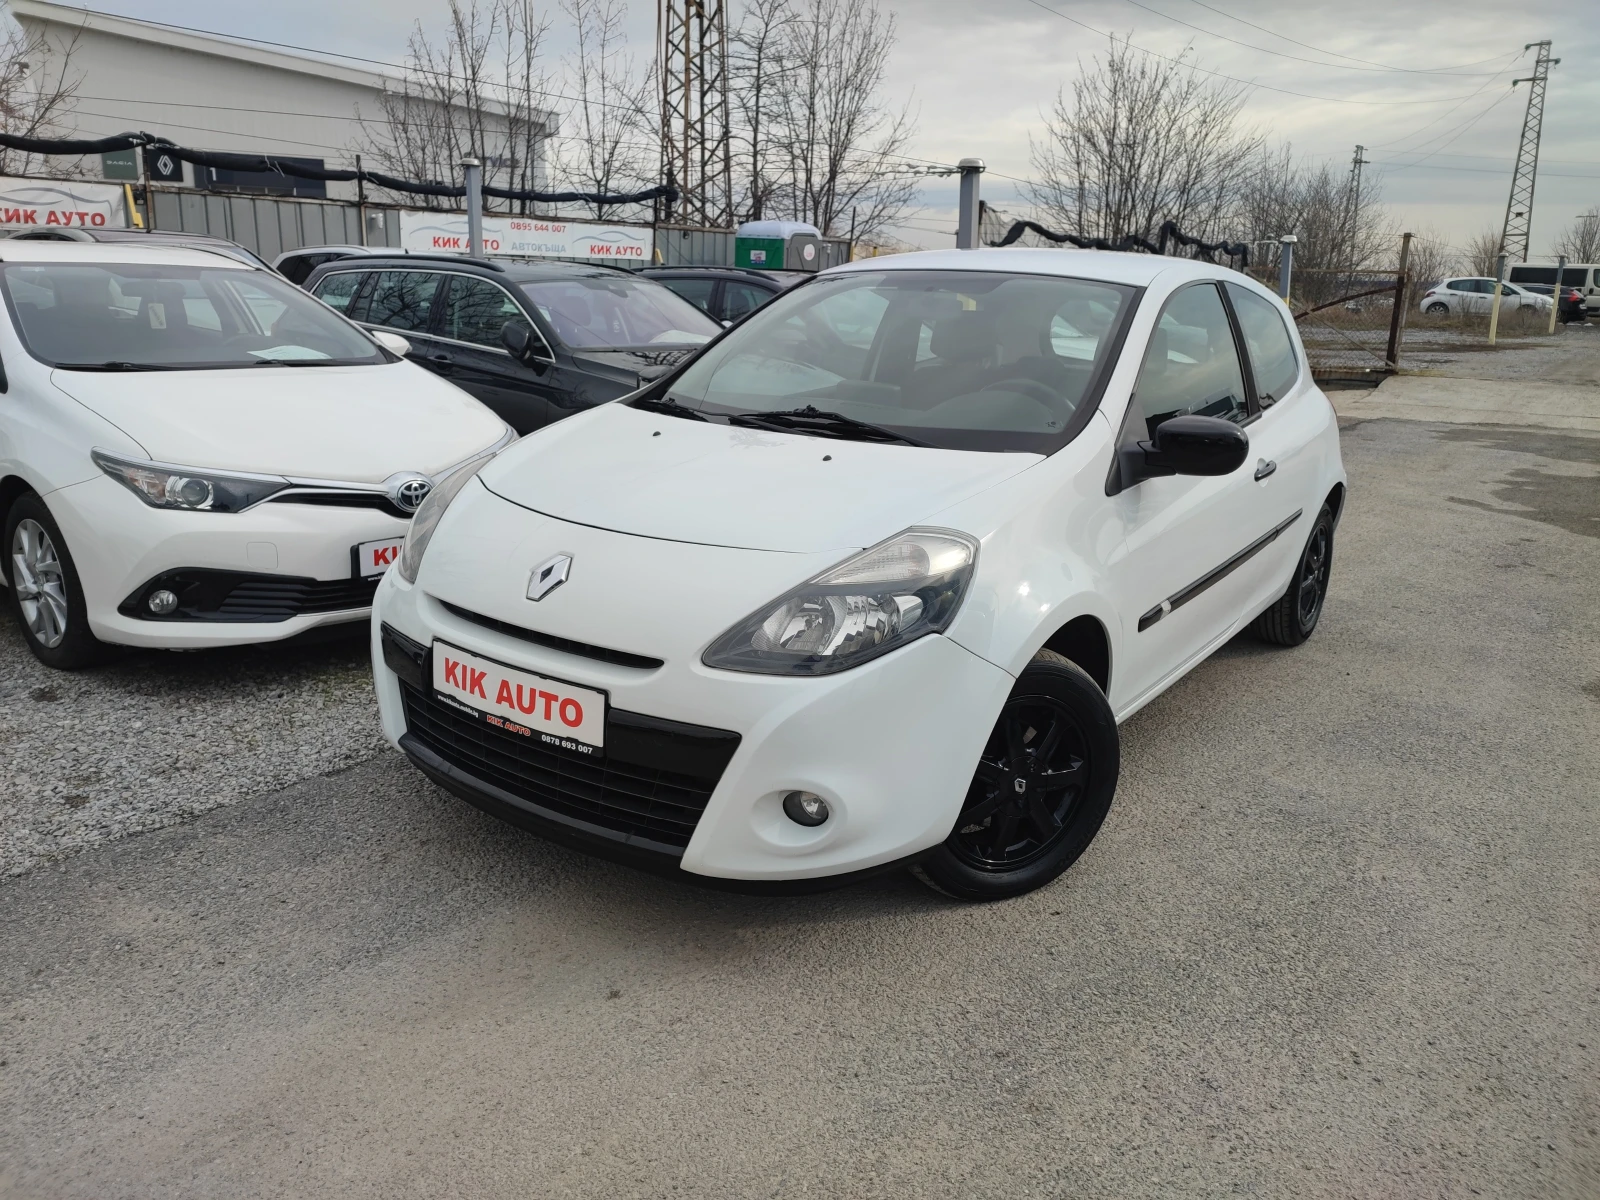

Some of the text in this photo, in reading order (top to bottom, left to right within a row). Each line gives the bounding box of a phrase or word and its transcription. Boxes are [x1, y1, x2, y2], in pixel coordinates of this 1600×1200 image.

[45, 210, 106, 227] АУТО
[510, 221, 567, 233] 0895 644 007
[433, 236, 500, 251] КИК АТО
[511, 241, 567, 254] АВТОКЪЩА
[590, 244, 643, 257] КИК АУТО
[373, 544, 403, 567] KI
[444, 656, 584, 728] KIK AUTO
[486, 714, 532, 737] KIK AUTO
[541, 734, 593, 755] 0878 693 007
